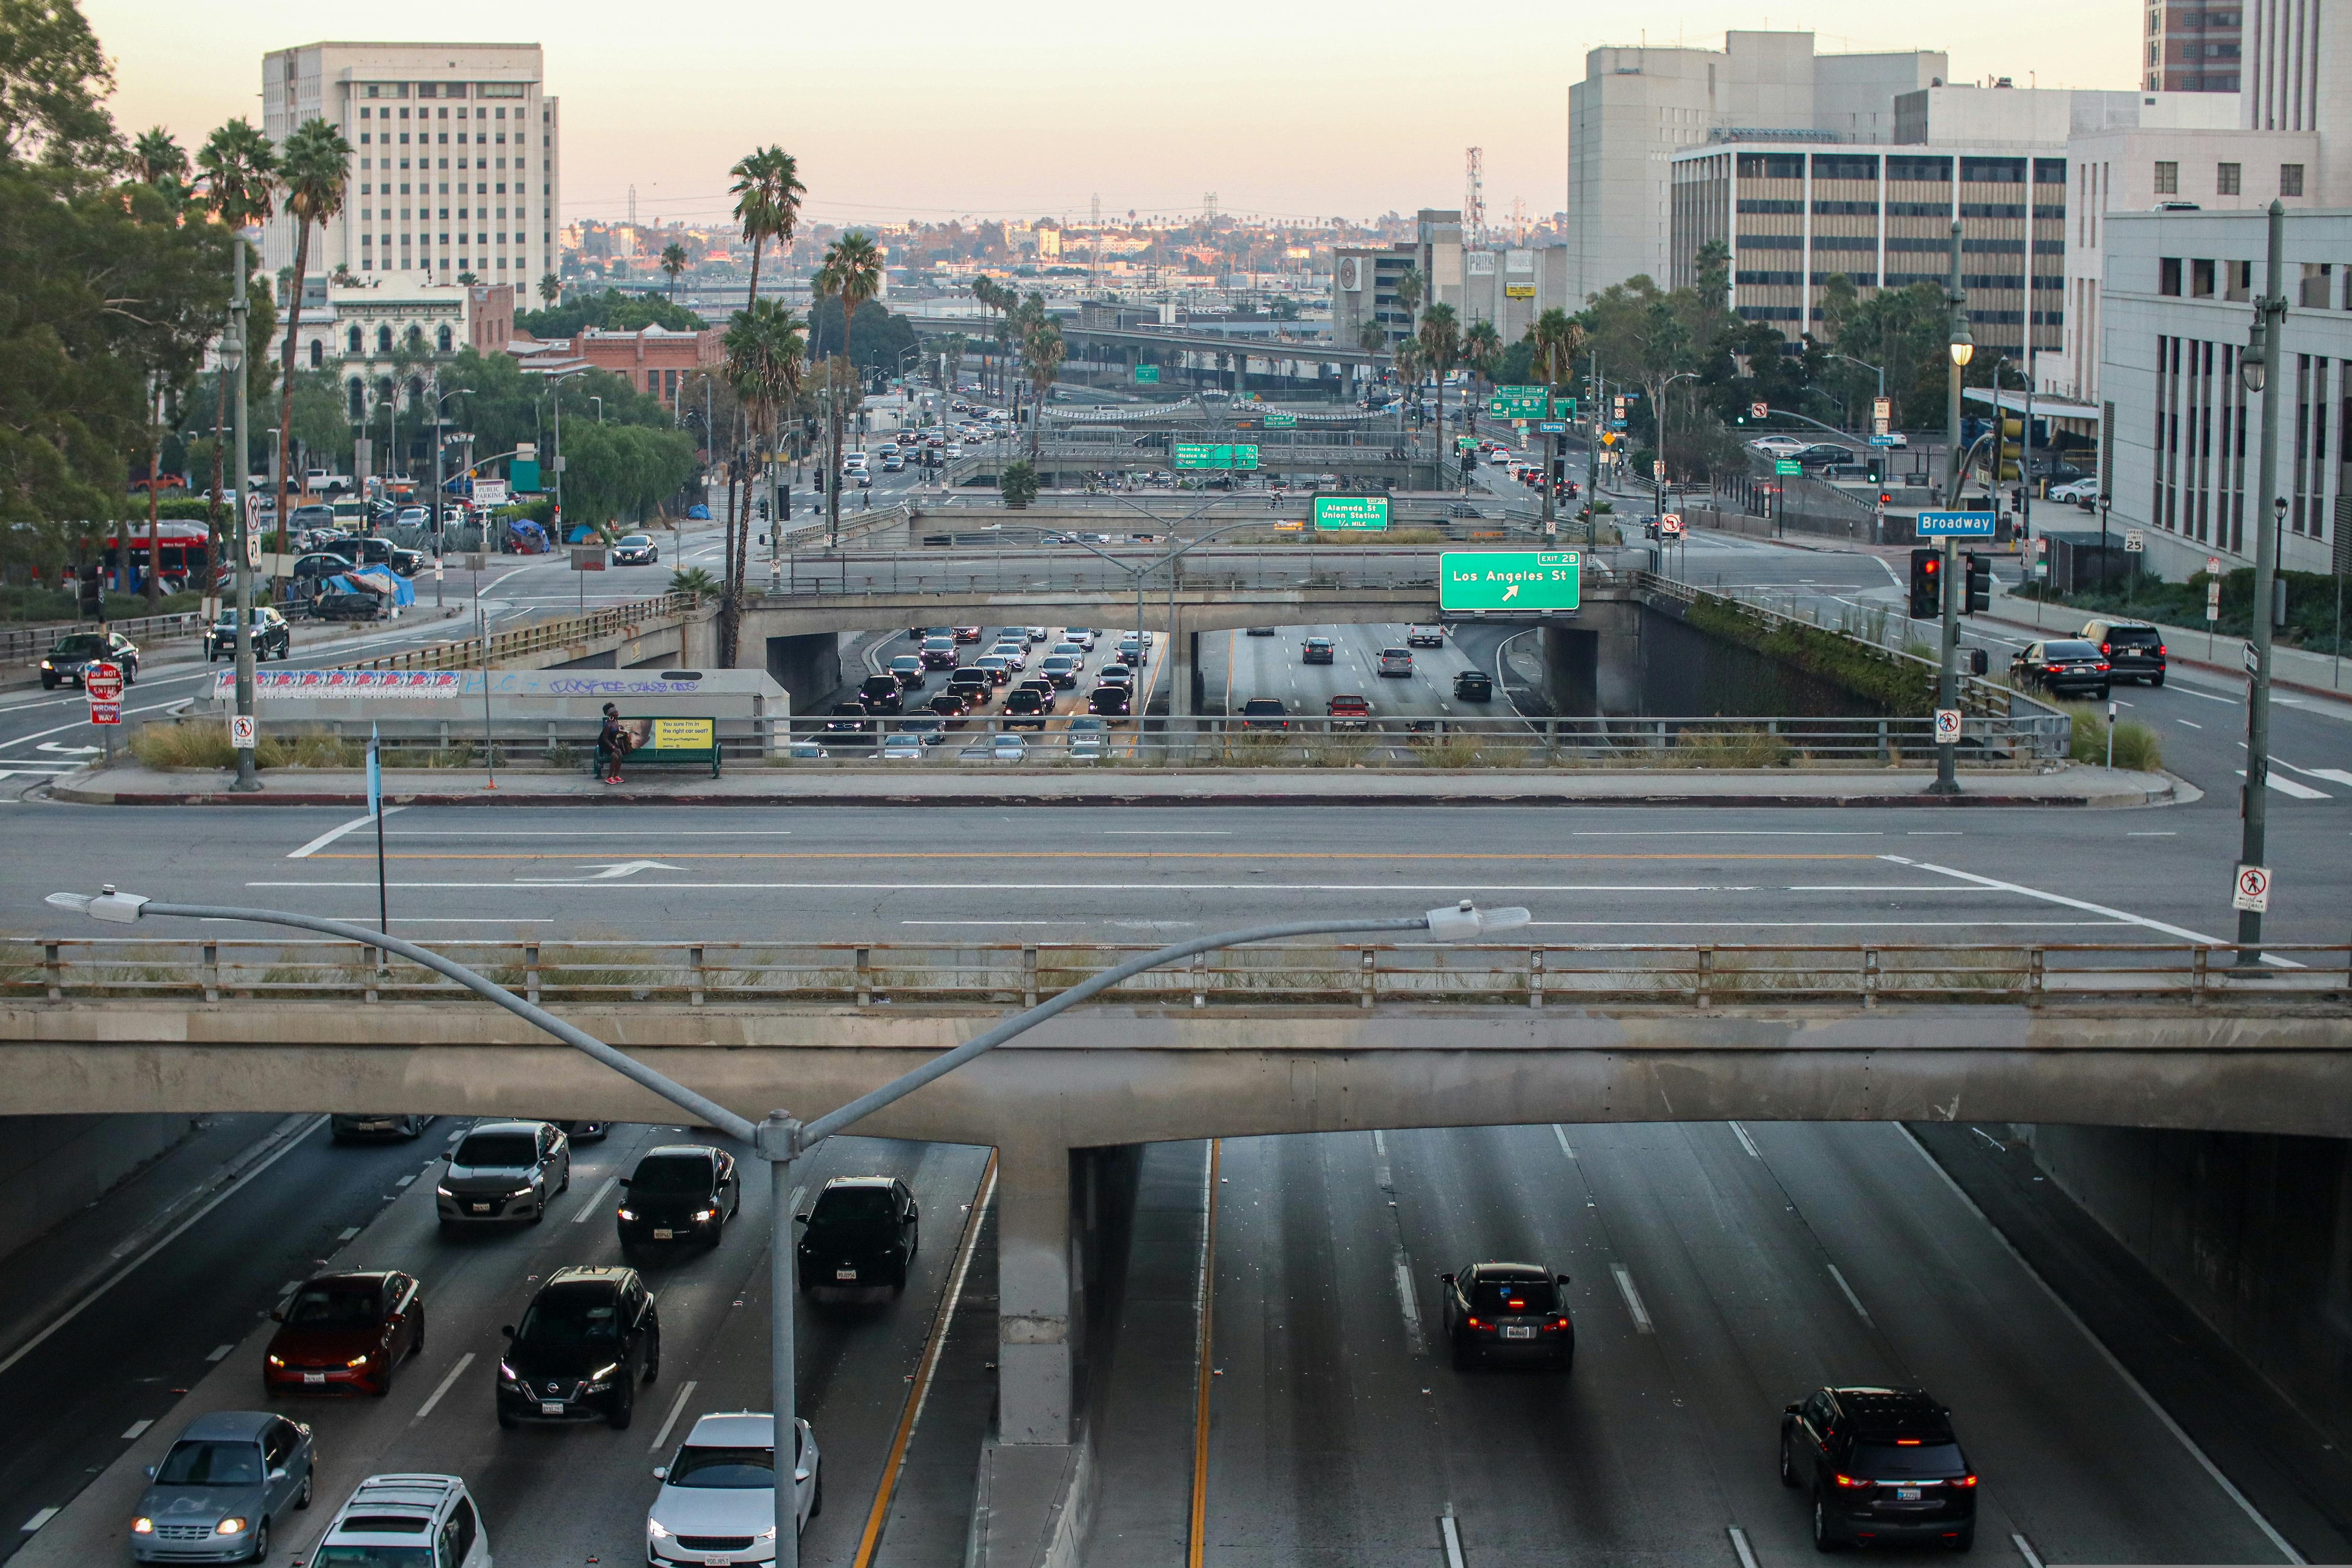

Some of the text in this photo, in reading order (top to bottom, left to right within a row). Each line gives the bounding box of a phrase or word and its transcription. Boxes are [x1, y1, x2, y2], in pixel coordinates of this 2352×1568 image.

[1470, 255, 1493, 271] PARK
[1923, 516, 1990, 531] Broadway
[2127, 541, 2141, 550] 25
[1562, 554, 1576, 562] 2B
[1453, 570, 1567, 584] Los Angeles St
